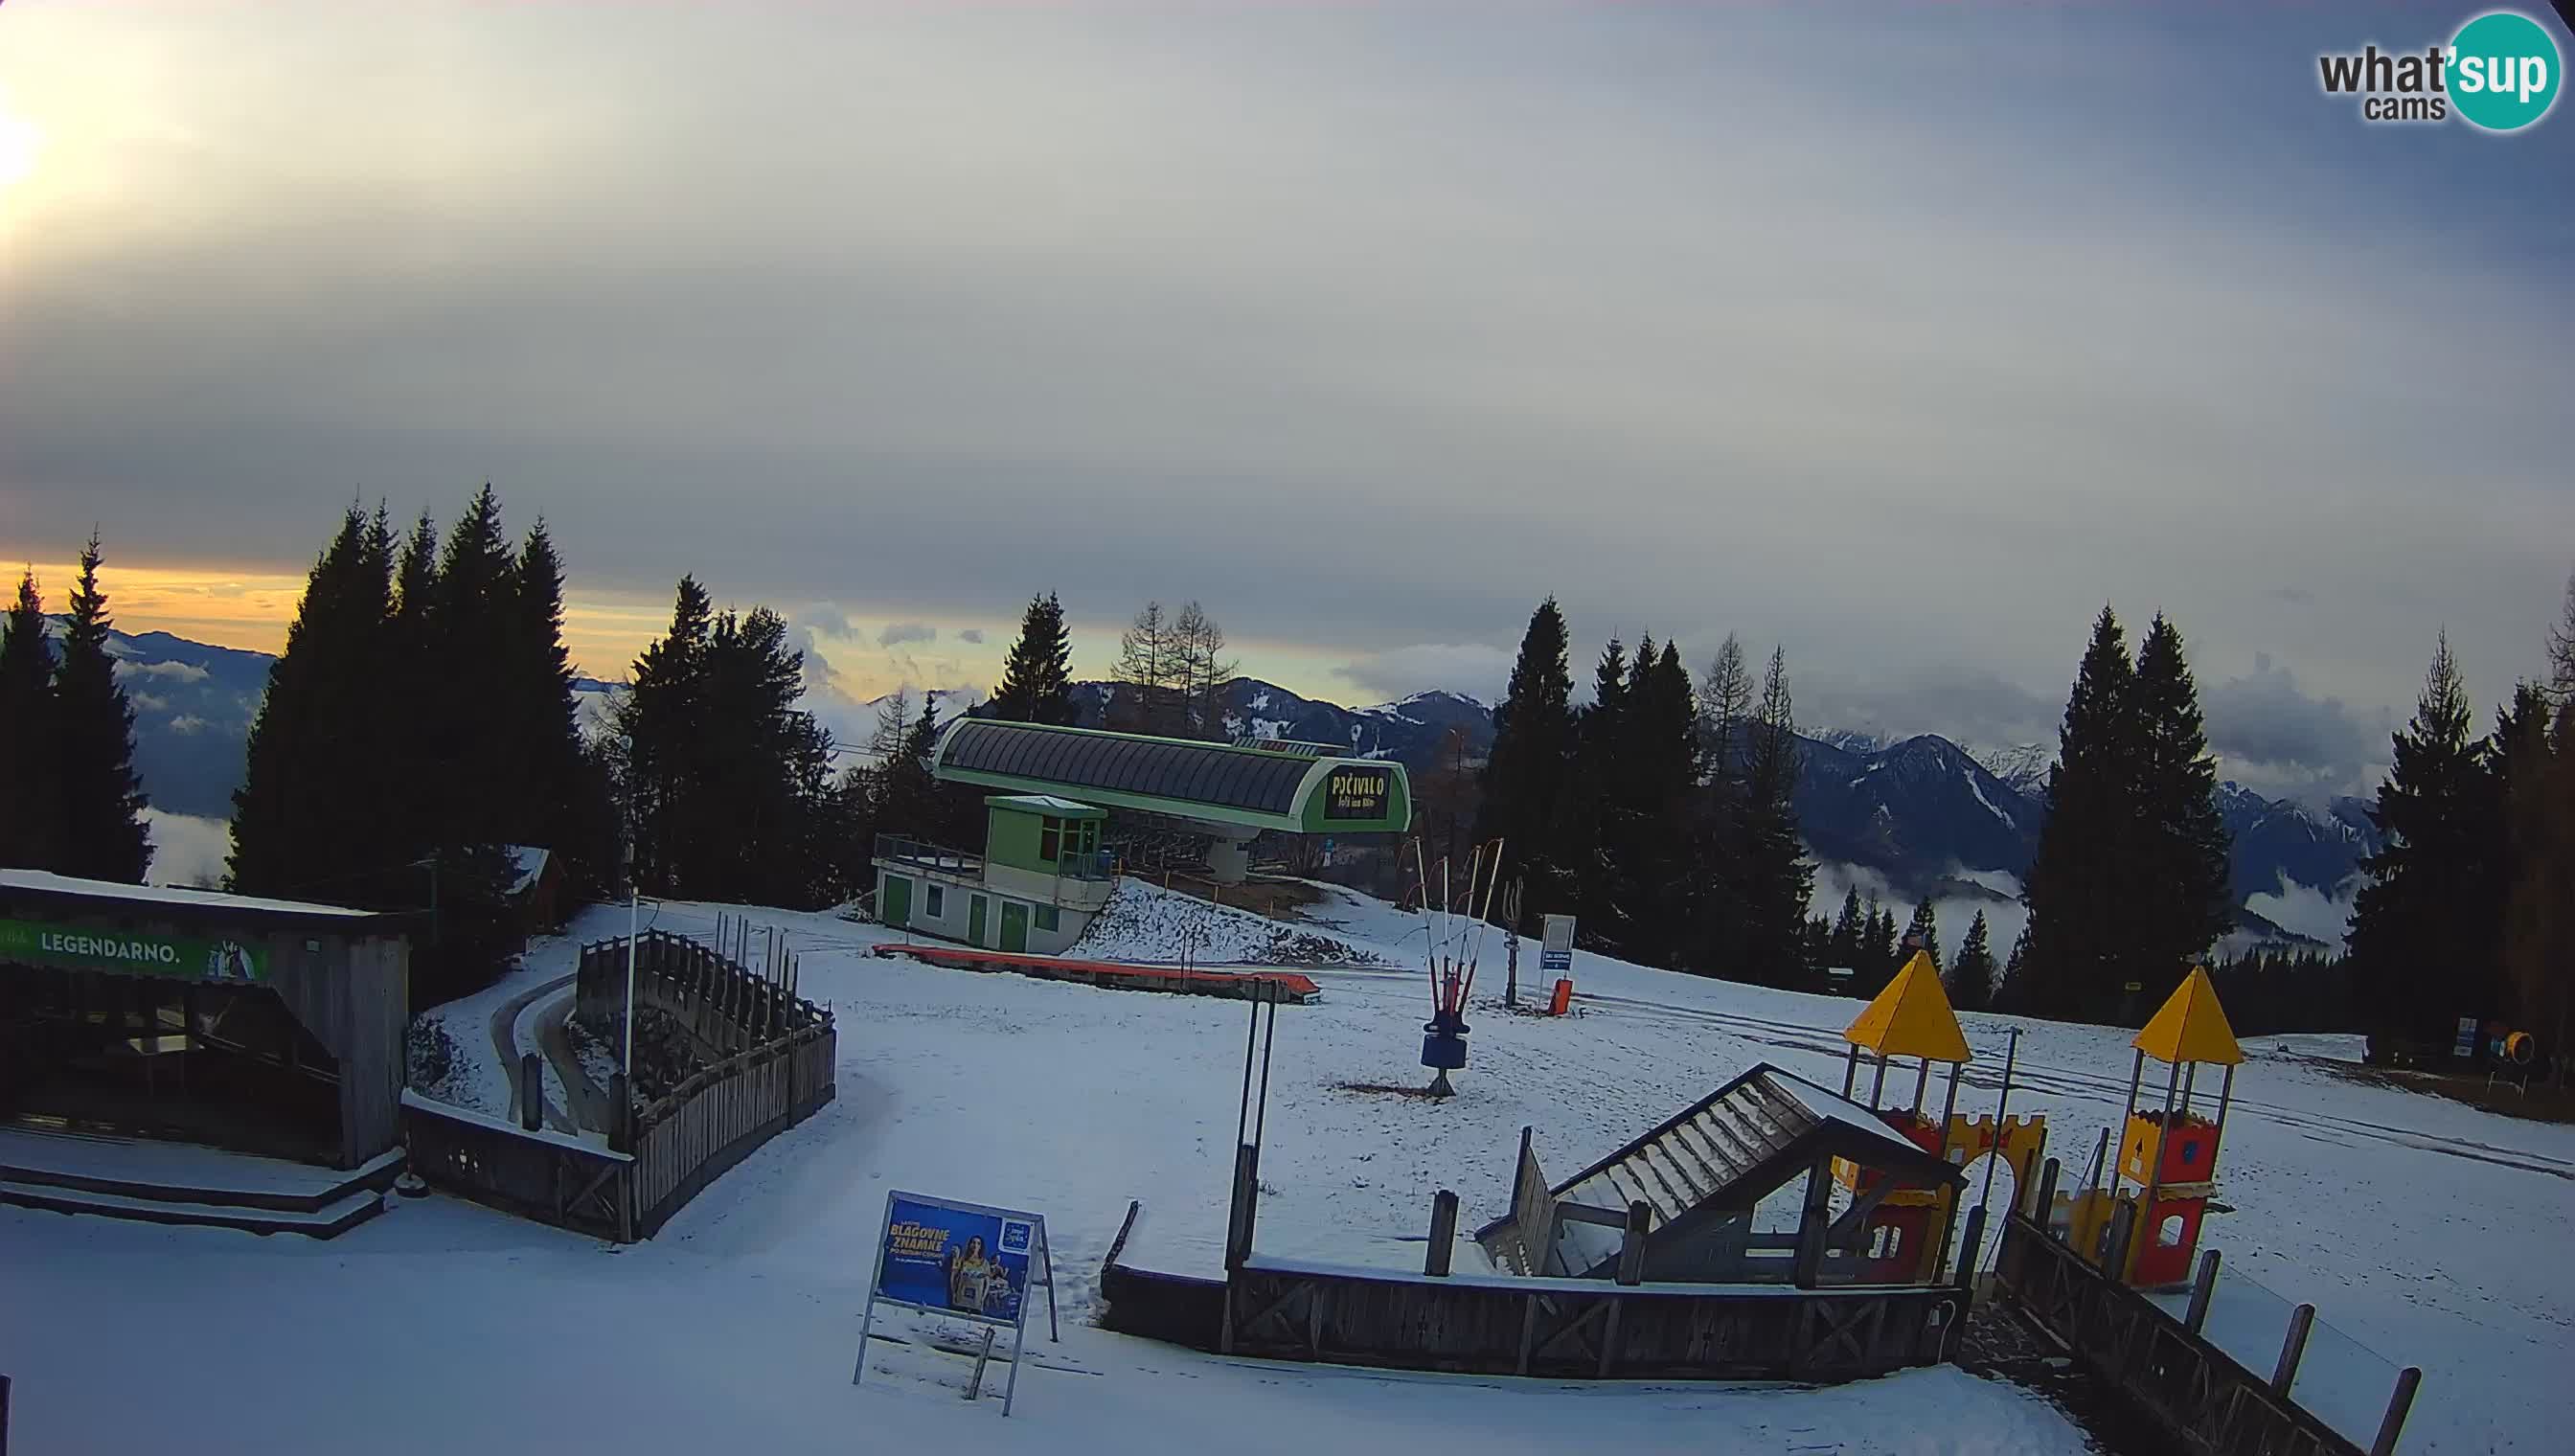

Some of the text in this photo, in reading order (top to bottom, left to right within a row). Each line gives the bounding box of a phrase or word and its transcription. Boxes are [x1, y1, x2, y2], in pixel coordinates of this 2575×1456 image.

[41, 932, 181, 964] LEGENDARNO.
[889, 1224, 950, 1241] BLAGOVNE
[893, 1237, 944, 1252] ZNAMKE
